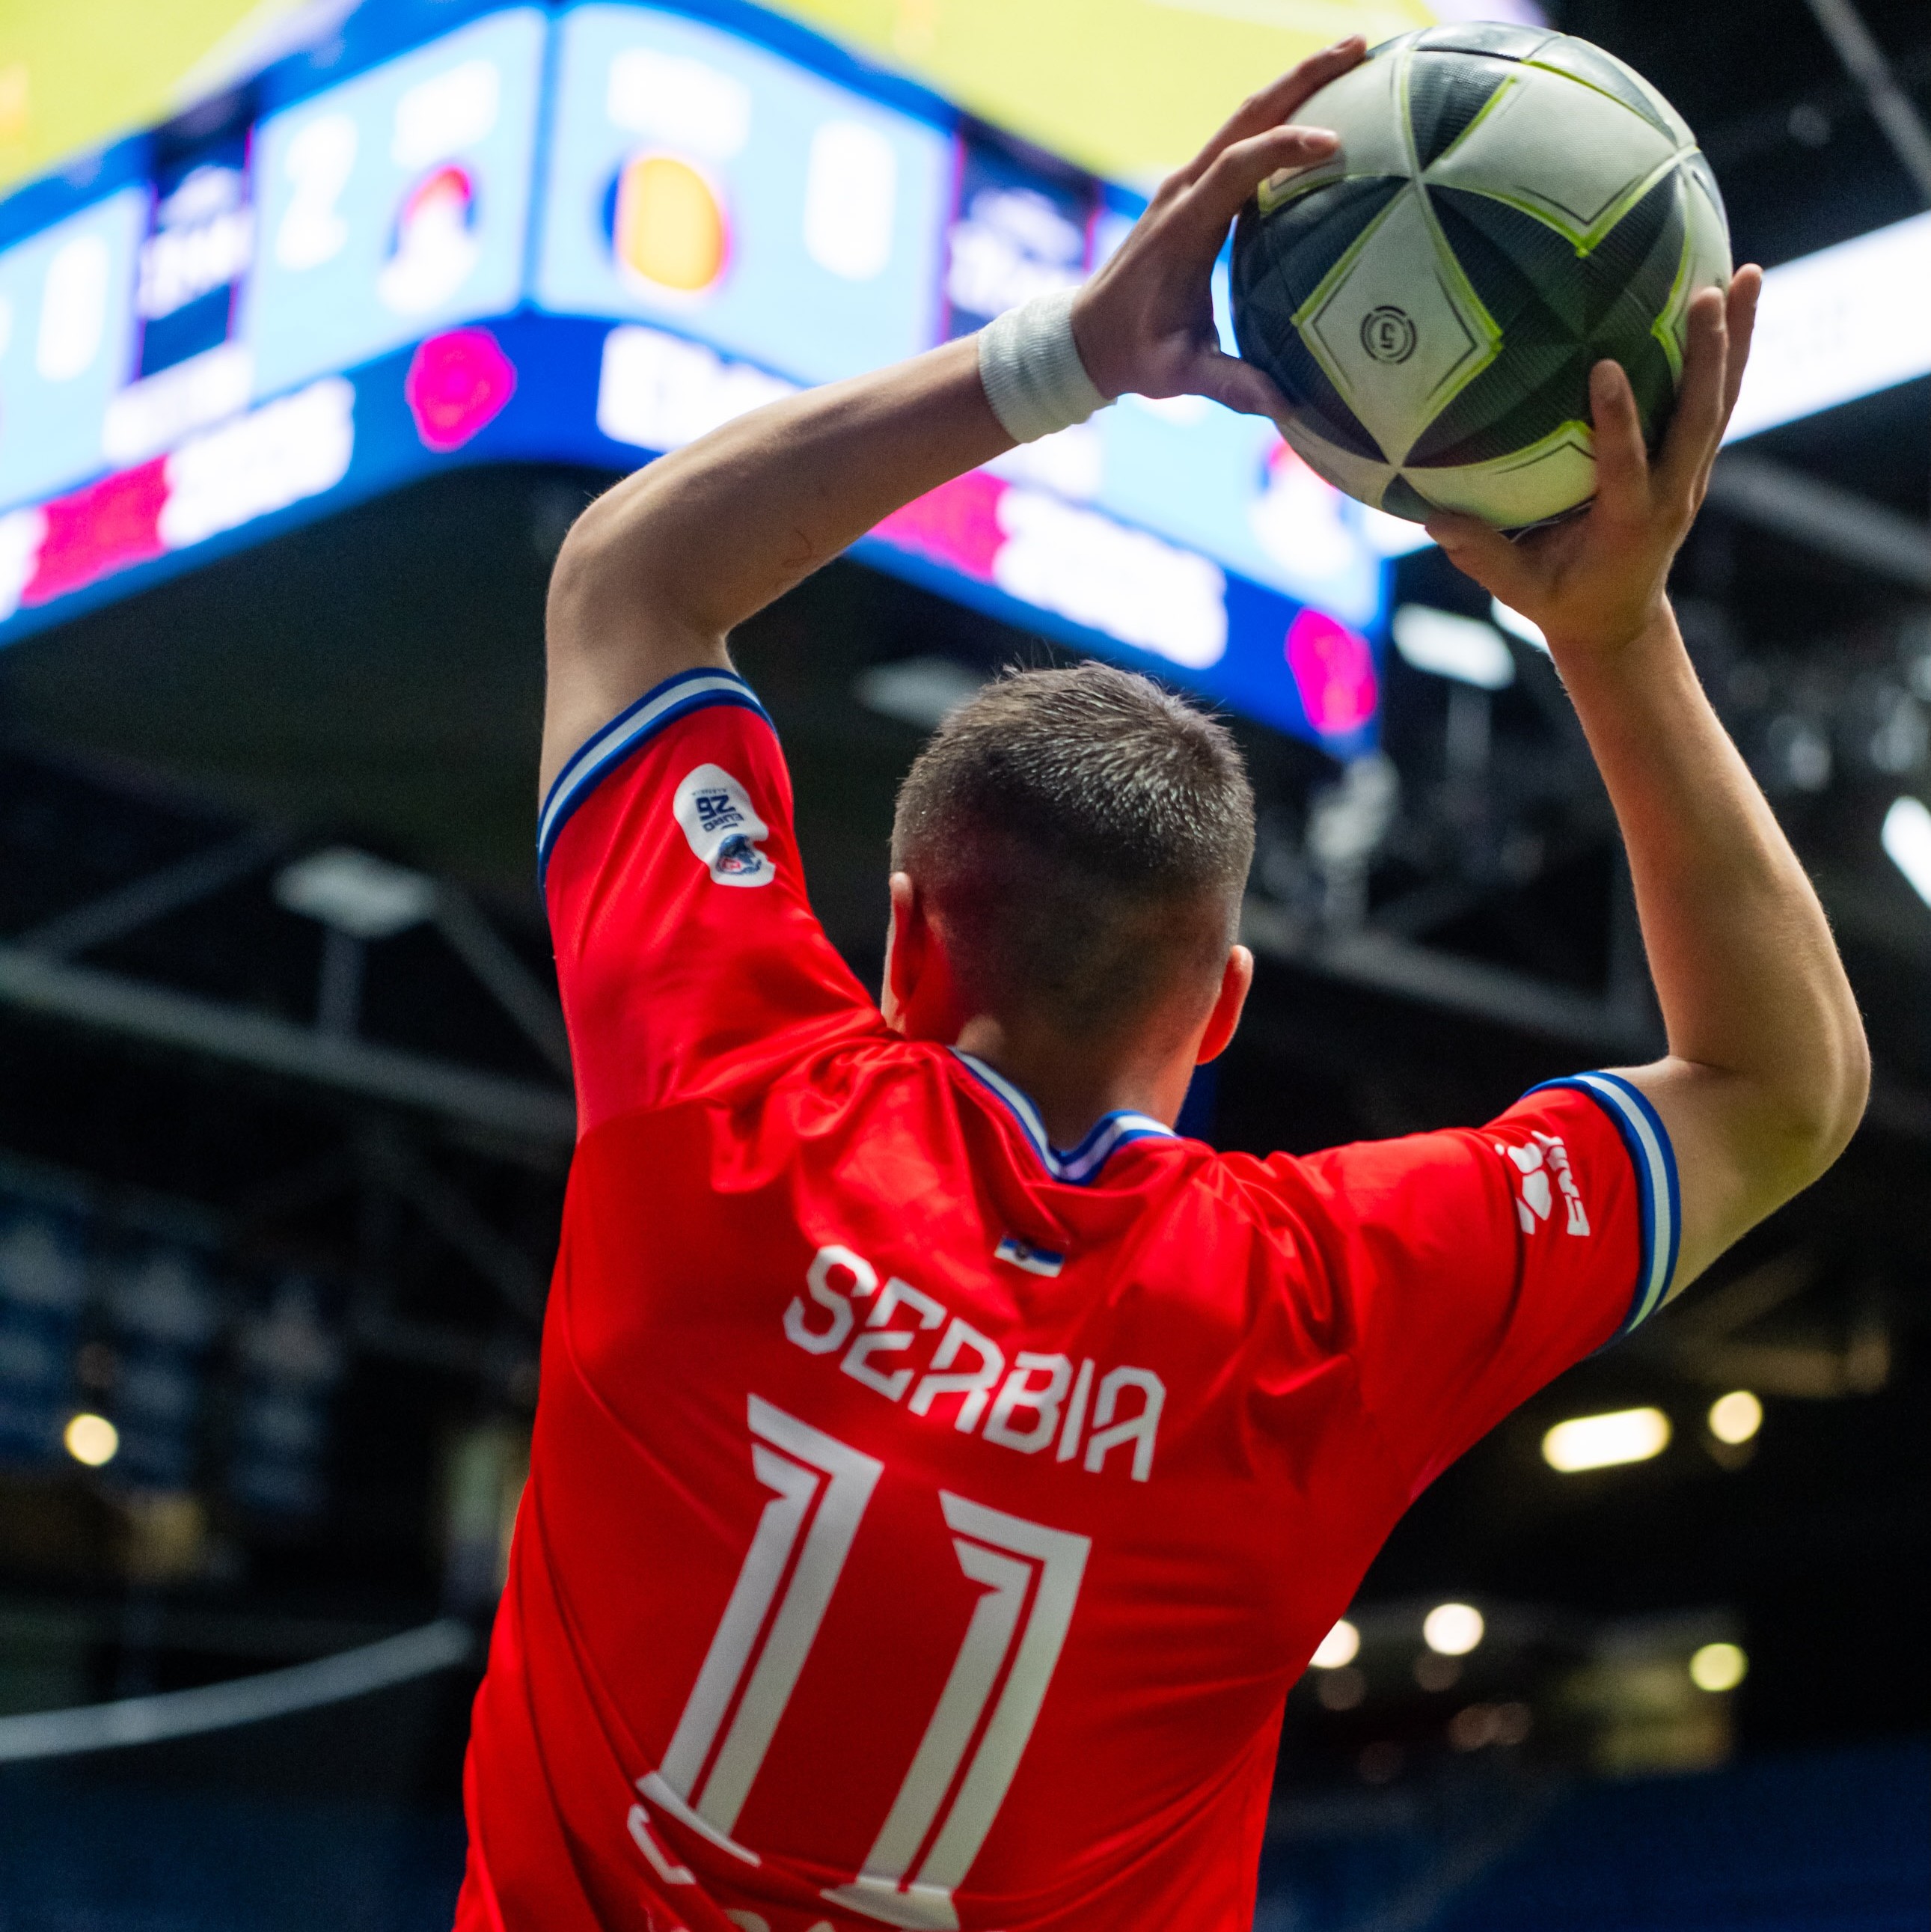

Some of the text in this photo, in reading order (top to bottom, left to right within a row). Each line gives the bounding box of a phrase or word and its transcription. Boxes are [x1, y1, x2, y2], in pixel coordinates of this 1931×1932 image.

[696, 795, 736, 821] 26
[782, 1244, 1167, 1482] SERBIA
[635, 1392, 1092, 1931] 11
